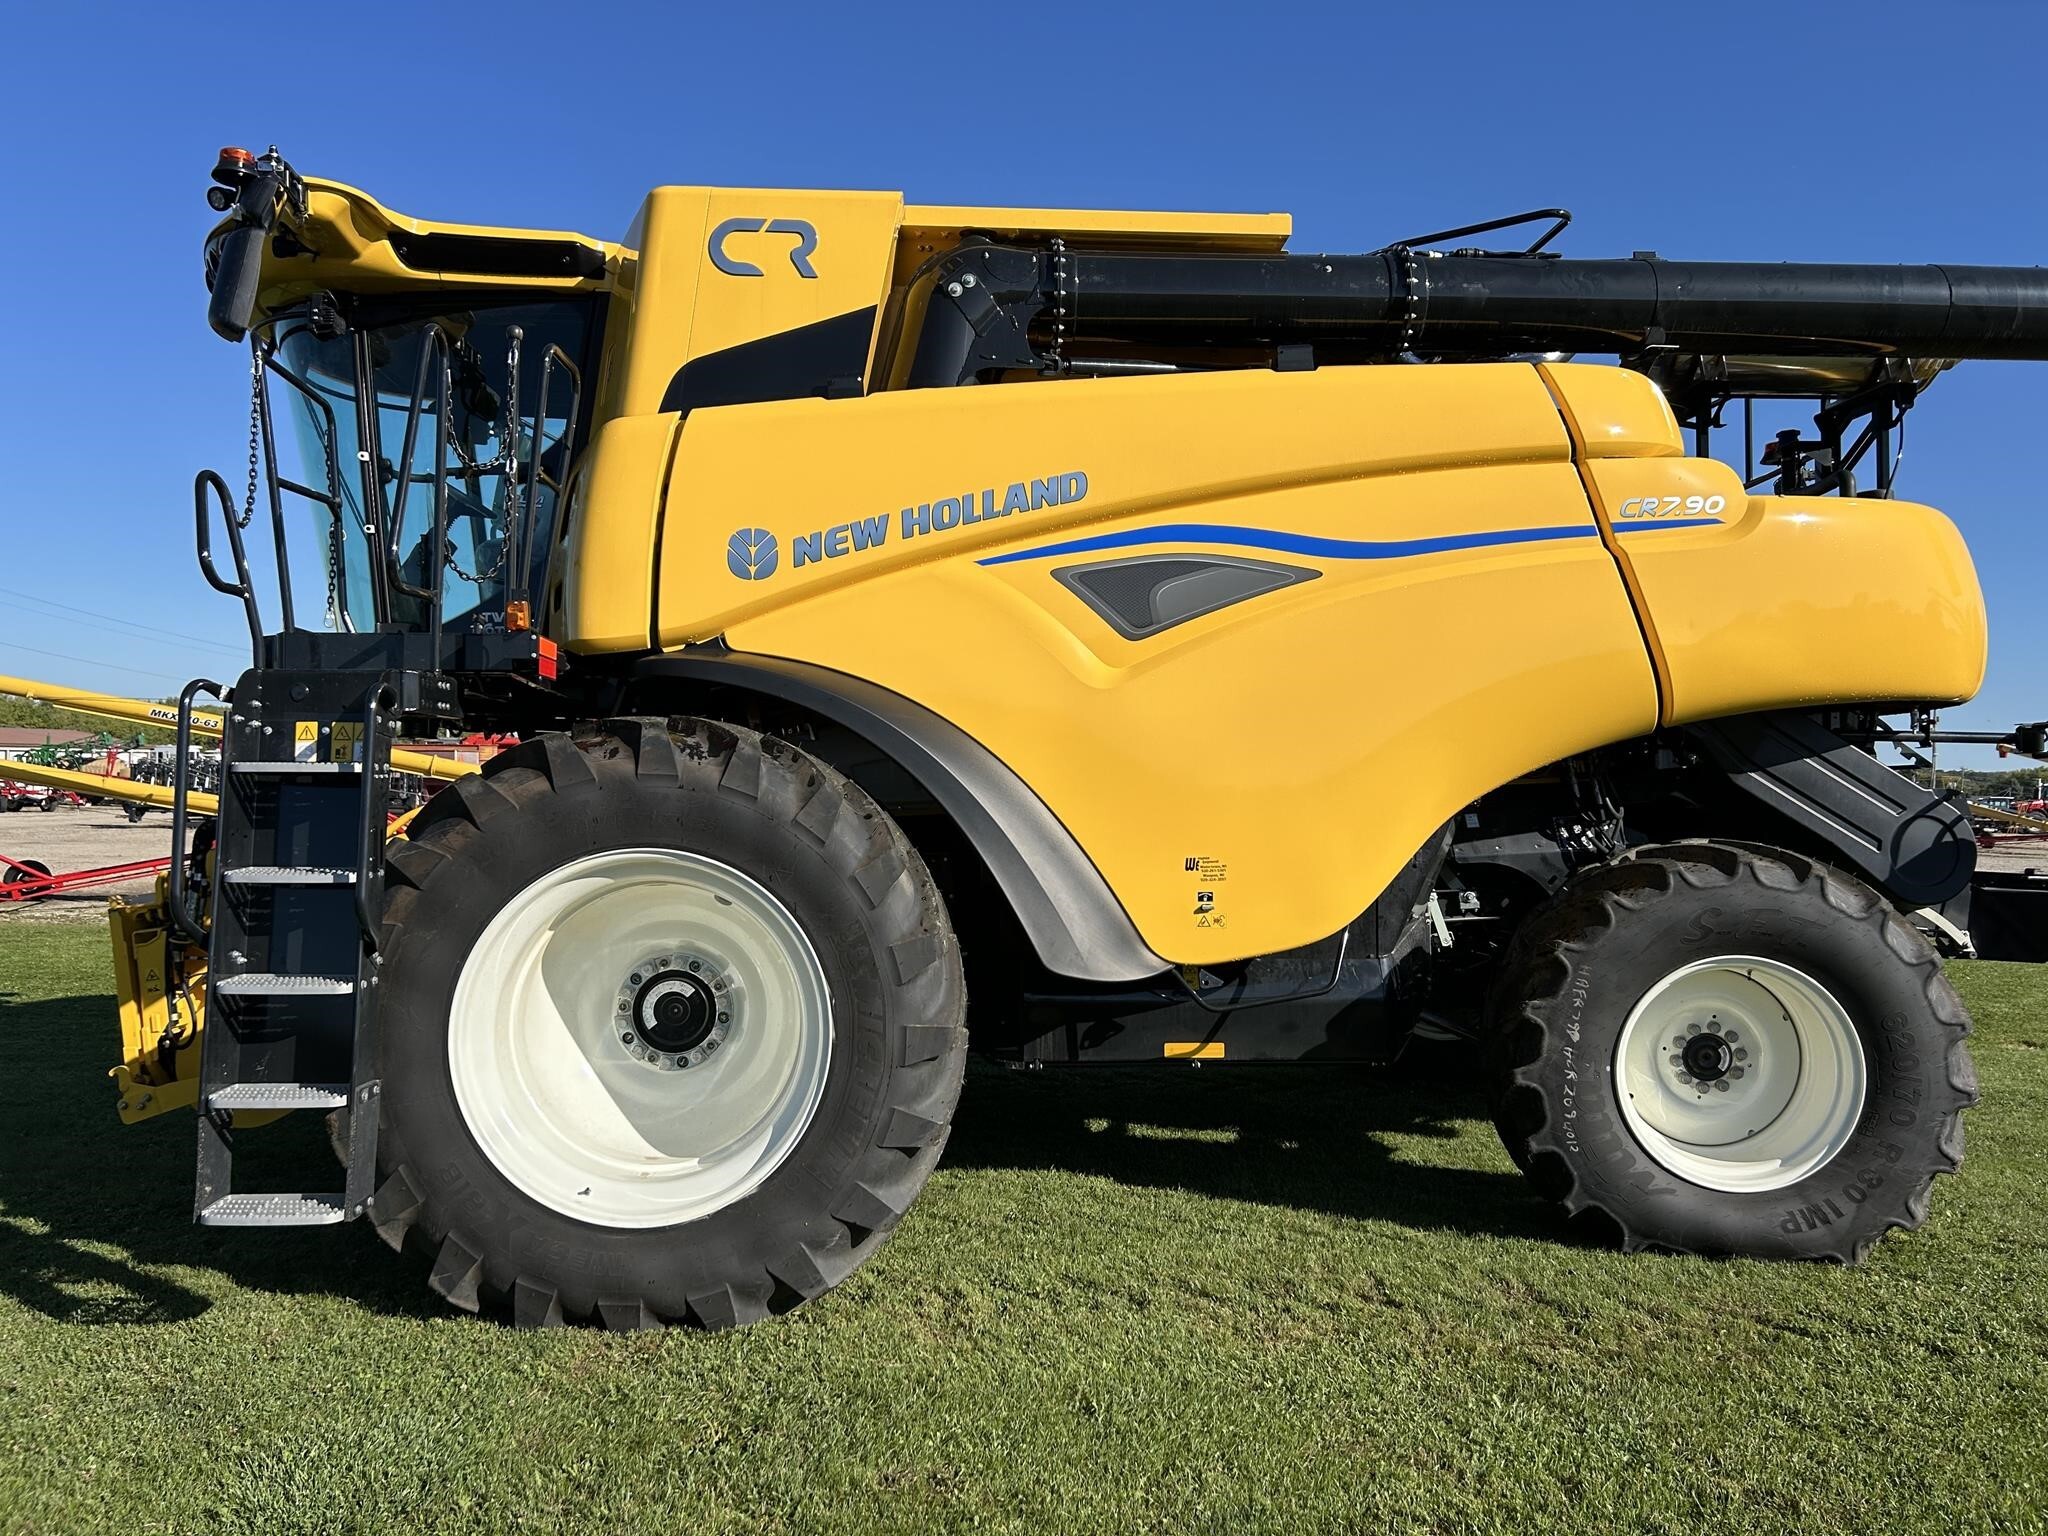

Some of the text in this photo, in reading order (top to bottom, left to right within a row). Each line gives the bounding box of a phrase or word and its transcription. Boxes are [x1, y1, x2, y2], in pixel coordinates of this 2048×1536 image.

[708, 217, 818, 279] CR
[793, 471, 1088, 568] NEW HOLLAND
[1619, 495, 1726, 518] CR7.90
[150, 709, 179, 721] MKX
